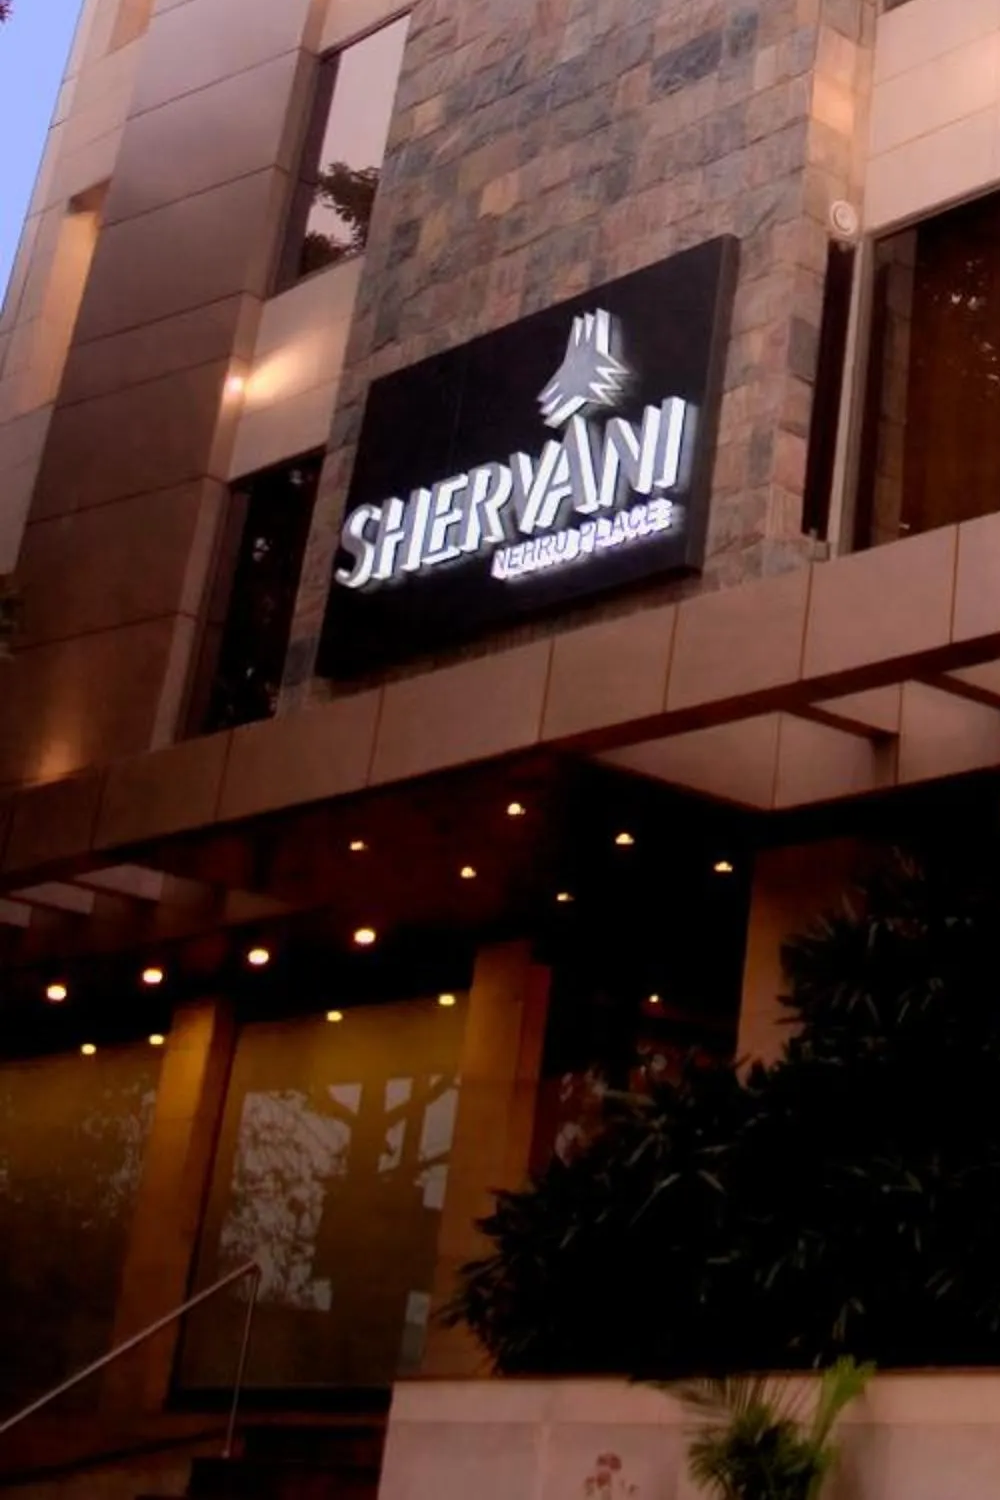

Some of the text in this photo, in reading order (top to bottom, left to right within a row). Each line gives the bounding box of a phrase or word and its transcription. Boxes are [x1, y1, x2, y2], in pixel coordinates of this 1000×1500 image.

[335, 396, 688, 589] SHERVANI
[491, 497, 673, 580] NEHRU PLACE
